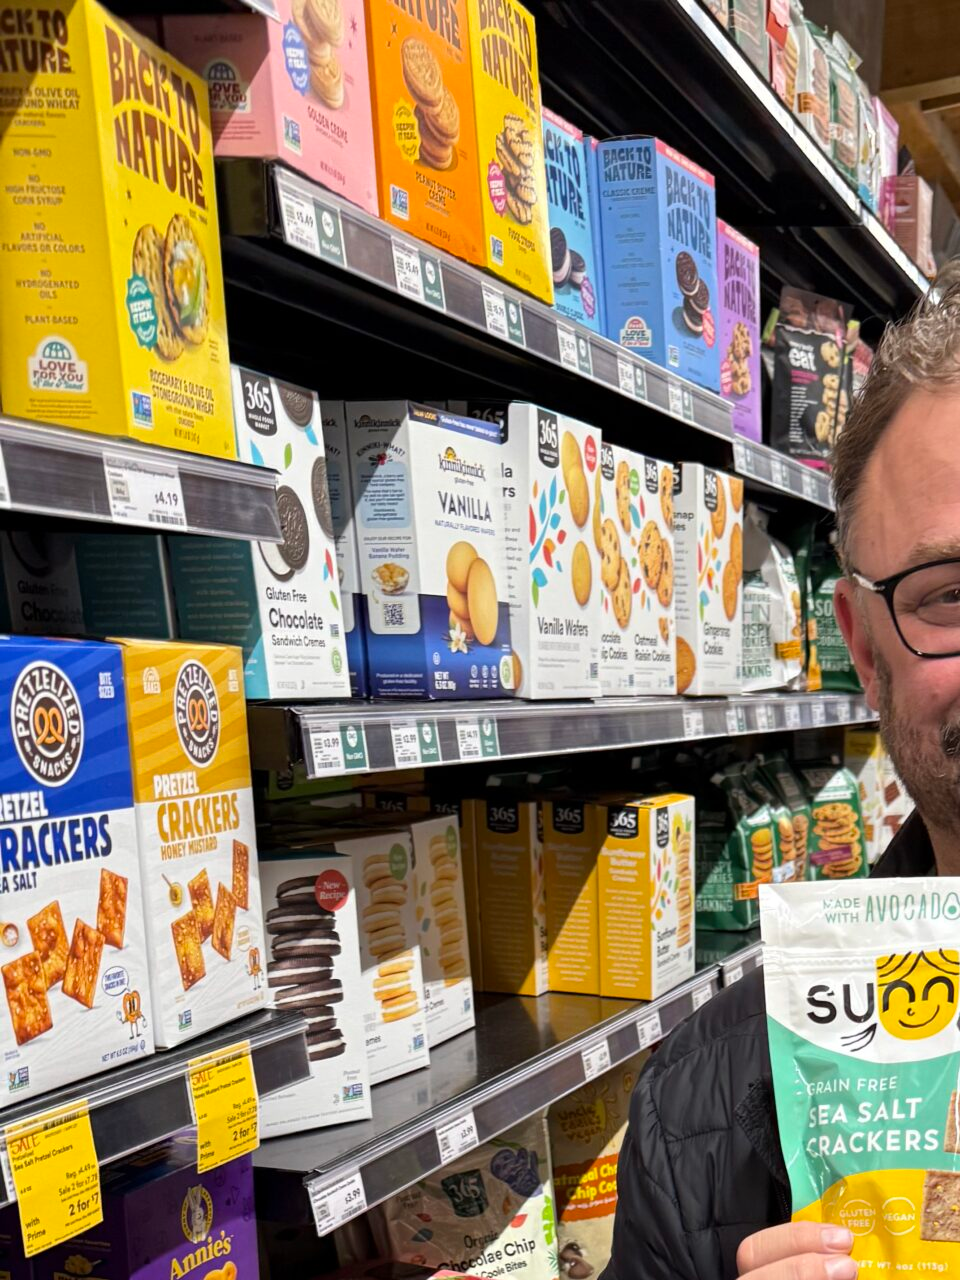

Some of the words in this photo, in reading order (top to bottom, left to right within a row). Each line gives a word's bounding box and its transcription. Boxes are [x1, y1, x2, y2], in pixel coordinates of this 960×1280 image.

[481, 32, 537, 114] NATURE
[105, 24, 170, 116] BACK
[170, 71, 201, 154] TO
[307, 105, 331, 133] GOLDEN
[113, 113, 207, 211] NATURE
[602, 147, 635, 166] BACK
[636, 146, 651, 165] TO
[604, 163, 652, 183] NATURE
[665, 164, 696, 208] BACK
[697, 184, 711, 231] TO
[296, 211, 314, 229] $5.49
[667, 206, 712, 260] NATURE
[724, 242, 747, 283] BACK
[16, 279, 80, 290] HYDROGENATED
[723, 279, 757, 325] NATURE
[39, 360, 76, 373] LOVE
[789, 347, 817, 372] eat
[150, 369, 183, 390] ROSEMARY
[188, 380, 206, 399] OLIVE
[205, 387, 215, 402] OIL
[152, 386, 196, 411] STONEGROUND
[196, 399, 215, 416] WHEAT
[245, 381, 273, 415] 365
[538, 418, 558, 449] 365
[438, 454, 487, 481] kinnikinnick
[155, 491, 179, 506] $4.19
[438, 490, 493, 523] VANILLA
[266, 586, 290, 602] Gluten
[292, 589, 307, 603] Free
[269, 607, 324, 631] Chocolate
[537, 616, 564, 635] Vanilla
[565, 618, 589, 637] Wafers
[272, 634, 302, 648] Sandwich
[303, 636, 326, 648] Cremes
[634, 633, 658, 647] Oatmeal
[15, 668, 80, 738] PRETZELIZED
[177, 664, 219, 726] PRETZELIZED
[188, 740, 214, 759] SNACKS
[32, 751, 73, 777] SNACKS
[153, 771, 199, 799] PRETZEL
[157, 792, 240, 844] CRACKERS
[609, 811, 637, 829] 365
[160, 843, 187, 861] HONEY
[188, 836, 218, 856] MUSTARD
[13, 871, 38, 891] SALT
[322, 880, 341, 892] New
[319, 888, 346, 902] Recipe
[823, 898, 860, 910] MADE
[825, 912, 860, 924] WITH
[807, 1078, 850, 1096] GRAIN
[857, 1076, 898, 1091] FREE
[809, 1104, 848, 1128] SEA
[858, 1097, 923, 1123] SALT
[807, 1129, 940, 1157] CRACKERS
[449, 1177, 482, 1203] 365
[69, 1203, 76, 1216] 2
[76, 1199, 91, 1214] for
[839, 1209, 876, 1219] GLUTEN
[884, 1213, 915, 1222] VEGAN
[25, 1217, 41, 1230] with
[848, 1219, 870, 1229] FREE
[27, 1229, 46, 1242] Prime
[504, 1237, 537, 1257] Chip
[506, 1259, 528, 1274] Bites
